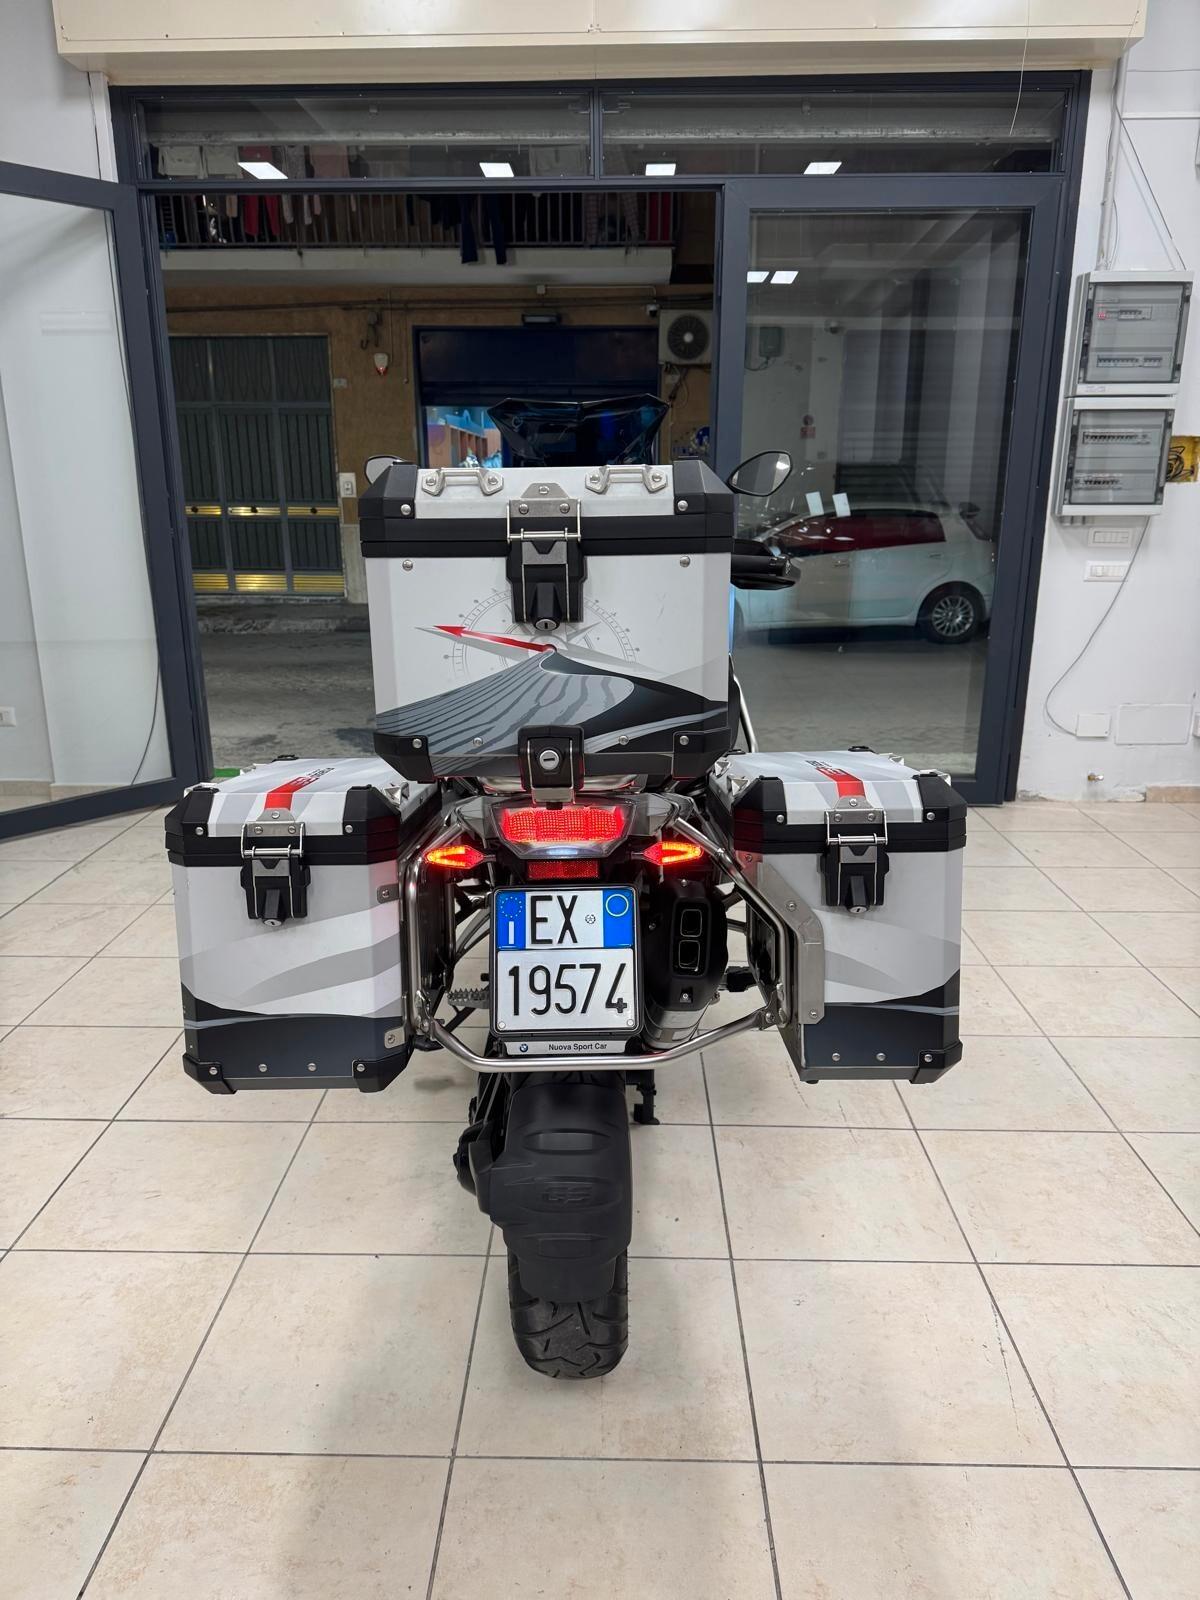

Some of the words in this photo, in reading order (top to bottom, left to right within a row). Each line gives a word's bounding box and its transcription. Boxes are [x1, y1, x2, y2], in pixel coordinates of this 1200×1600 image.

[530, 895, 578, 945] EX
[508, 963, 628, 1016] 19574
[548, 1043, 572, 1051] Nuova
[573, 1043, 593, 1052] Sport
[594, 1042, 608, 1050] Car
